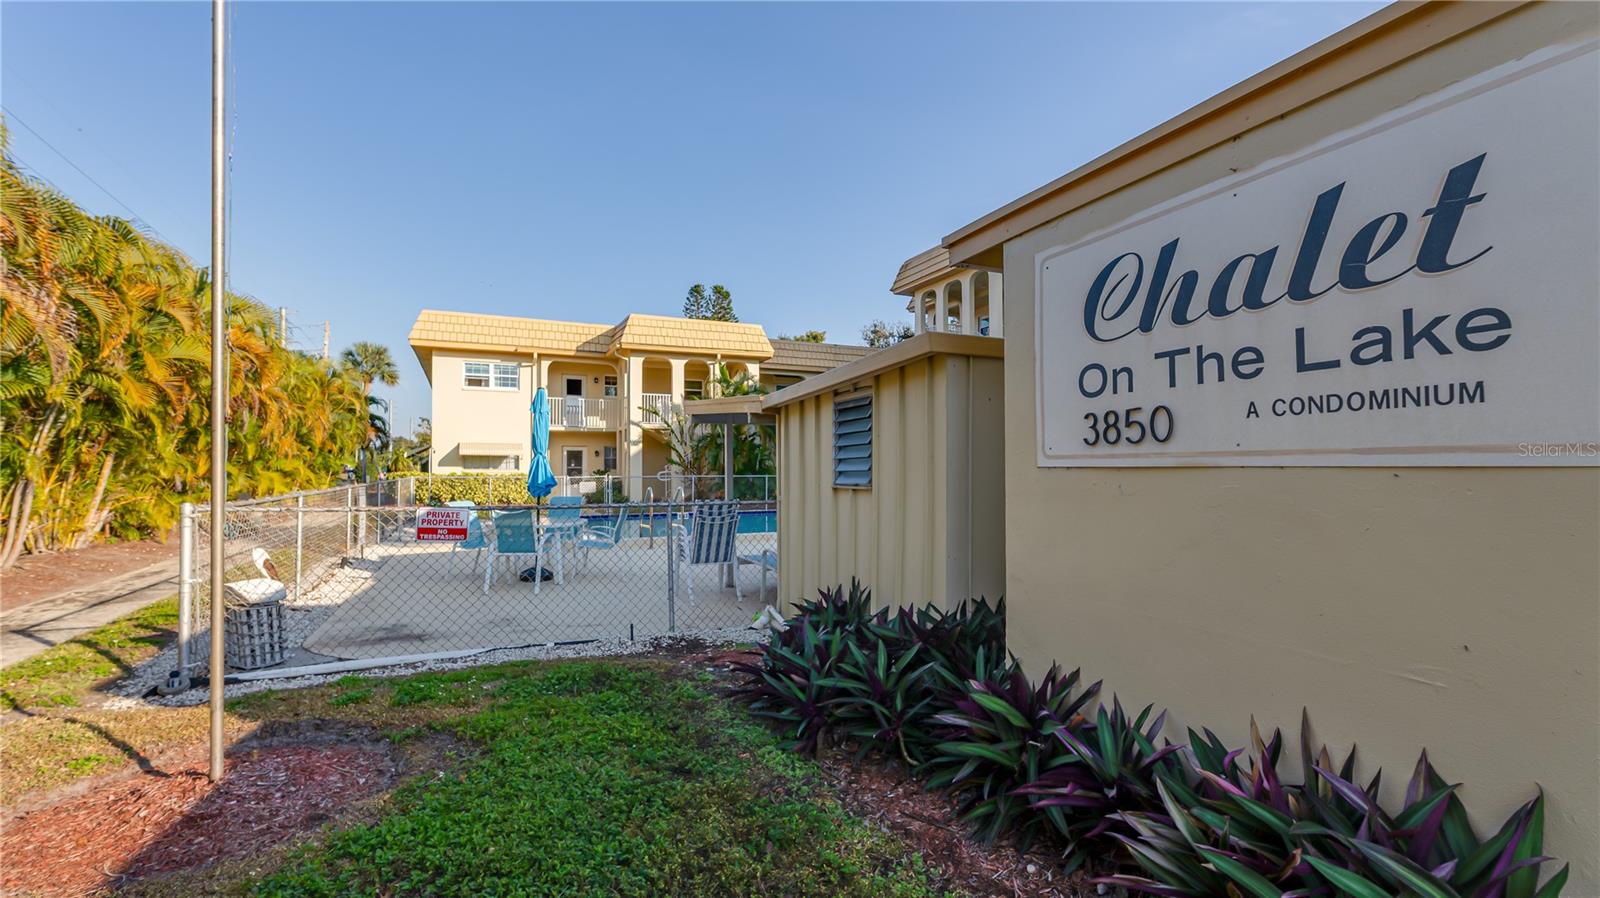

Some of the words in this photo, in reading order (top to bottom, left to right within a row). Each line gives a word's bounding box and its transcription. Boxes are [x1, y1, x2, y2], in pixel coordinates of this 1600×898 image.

[1083, 152, 1493, 342] Chalet
[1078, 362, 1134, 398] On
[1154, 345, 1265, 388] The
[1295, 307, 1512, 373] Lake
[1245, 400, 1260, 419] A
[1271, 380, 1486, 418] CONDOMINIUM
[1082, 405, 1175, 446] 3850
[421, 518, 464, 526] PROPERTY
